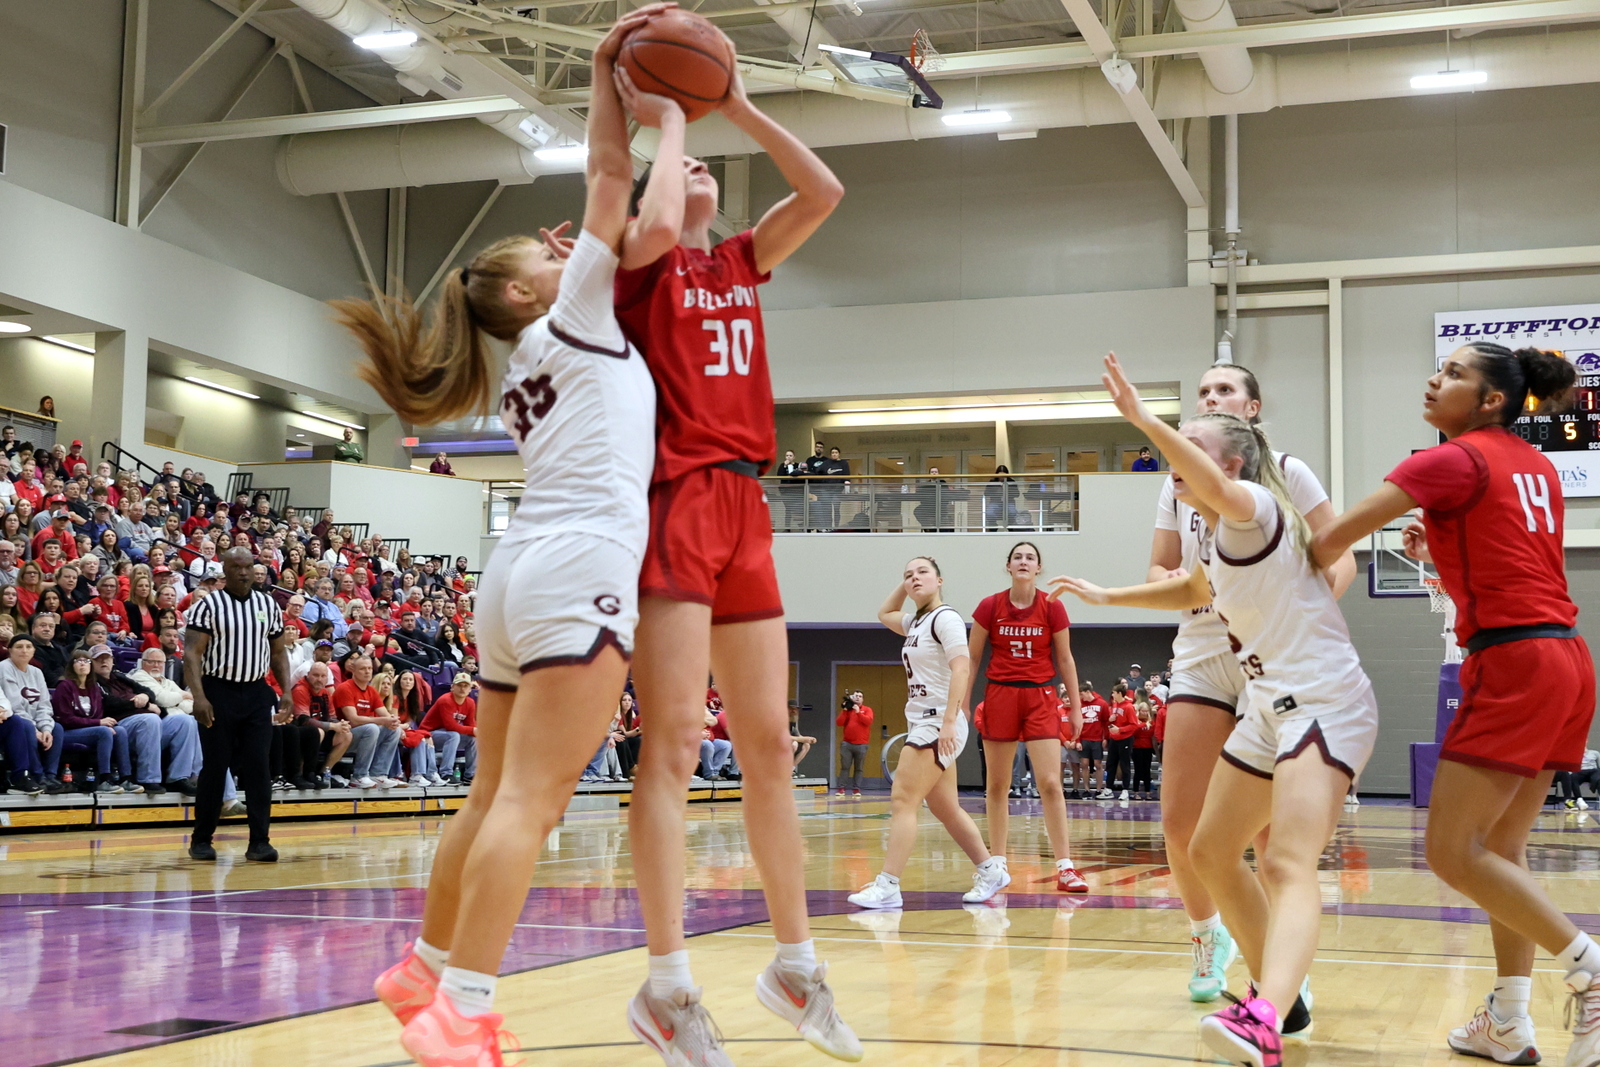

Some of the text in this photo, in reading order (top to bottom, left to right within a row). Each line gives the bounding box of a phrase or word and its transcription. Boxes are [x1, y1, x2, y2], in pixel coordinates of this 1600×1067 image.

[1448, 329, 1594, 343] UNIVERSITY
[702, 318, 754, 376] 30
[1573, 376, 1600, 388] UES
[1534, 415, 1552, 423] FOUL
[1559, 414, 1579, 422] T.O.L.
[1587, 413, 1600, 421] FOU
[1588, 442, 1600, 450] SCO
[1558, 465, 1588, 482] TA'S
[1512, 473, 1555, 534] 14
[999, 625, 1043, 637] BELLEVUE
[1010, 640, 1032, 659] 21
[902, 652, 914, 680] 3
